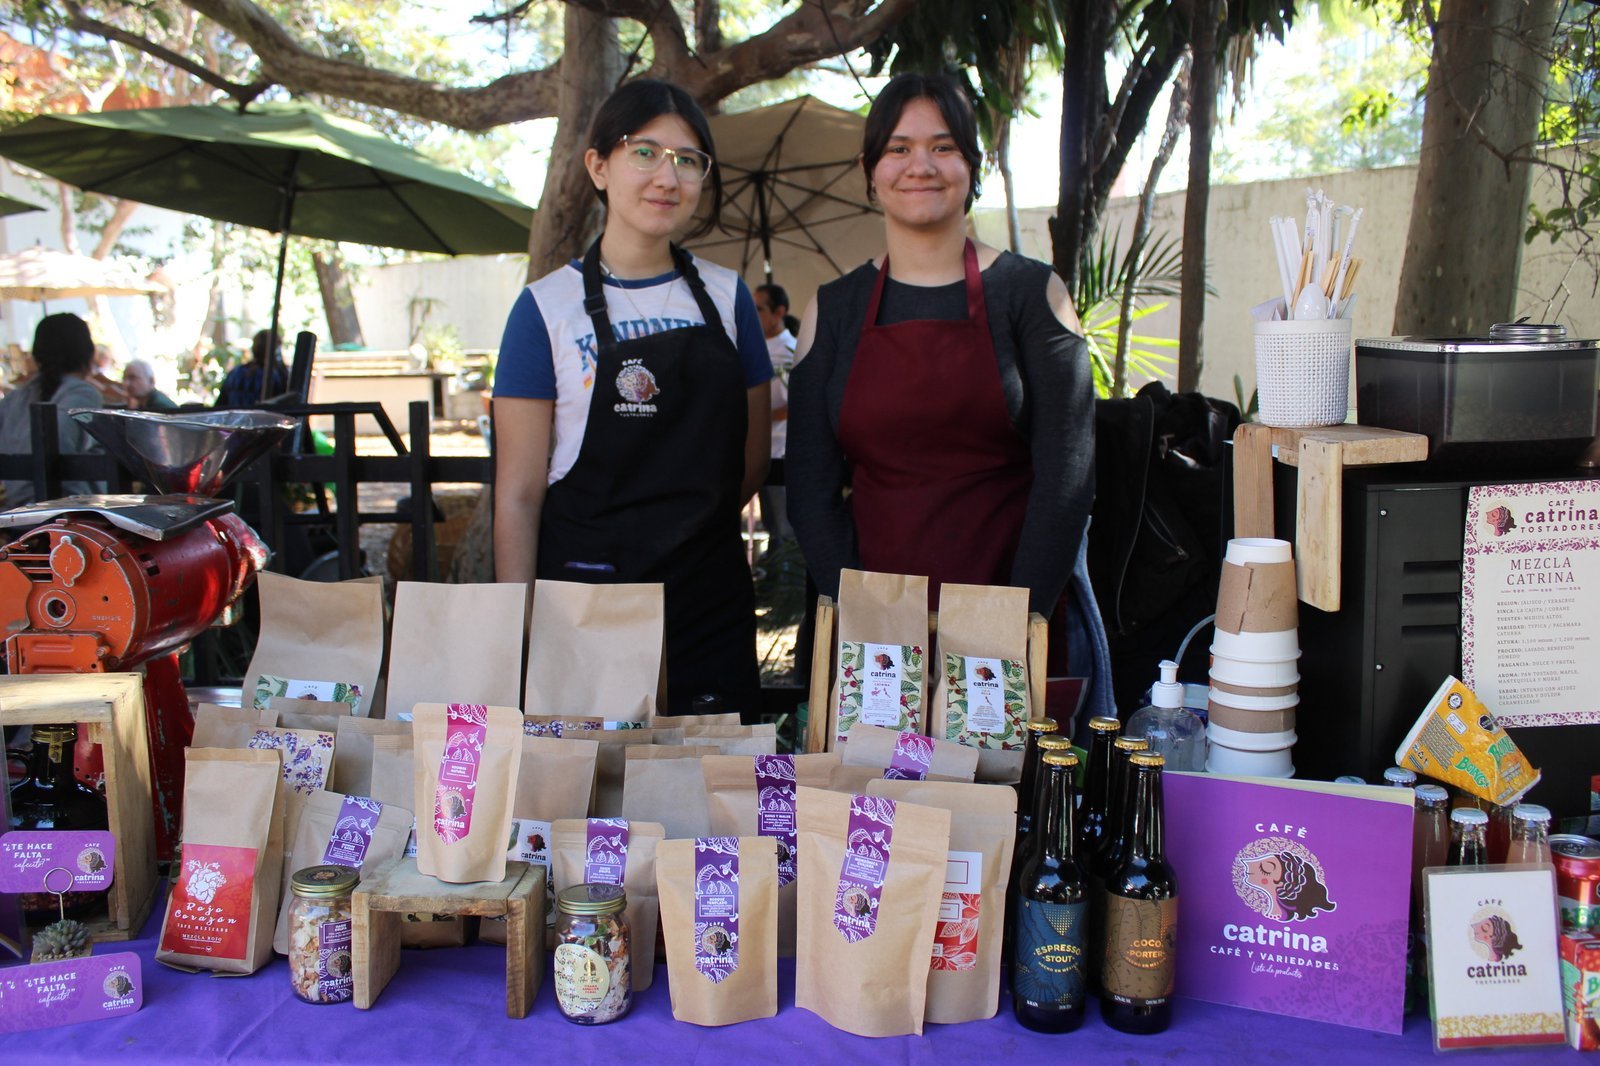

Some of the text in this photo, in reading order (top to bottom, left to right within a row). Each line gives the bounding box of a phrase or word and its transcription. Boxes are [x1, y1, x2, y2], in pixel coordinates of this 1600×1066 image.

[613, 402, 658, 413] catrina
[1548, 499, 1575, 507] CAFÉ
[1525, 507, 1599, 524] catrina
[1510, 557, 1572, 571] MEZCLA
[1506, 571, 1575, 586] CATRINA
[1255, 823, 1308, 839] CAFÉ
[521, 851, 546, 861] catrina
[74, 873, 105, 881] catrina
[186, 902, 224, 916] Rojo
[1477, 898, 1503, 907] CAFÉ
[174, 909, 237, 926] Corazón
[838, 914, 870, 928] catrina
[1223, 923, 1328, 954] catrina
[700, 955, 733, 964] catrina
[1210, 945, 1340, 971] CAFÉ Y VARIEDADES
[1467, 961, 1528, 979] catrina
[49, 972, 77, 983] HACE
[324, 975, 352, 987] catrin
[37, 983, 67, 994] FALTA
[102, 996, 135, 1008] catrina
